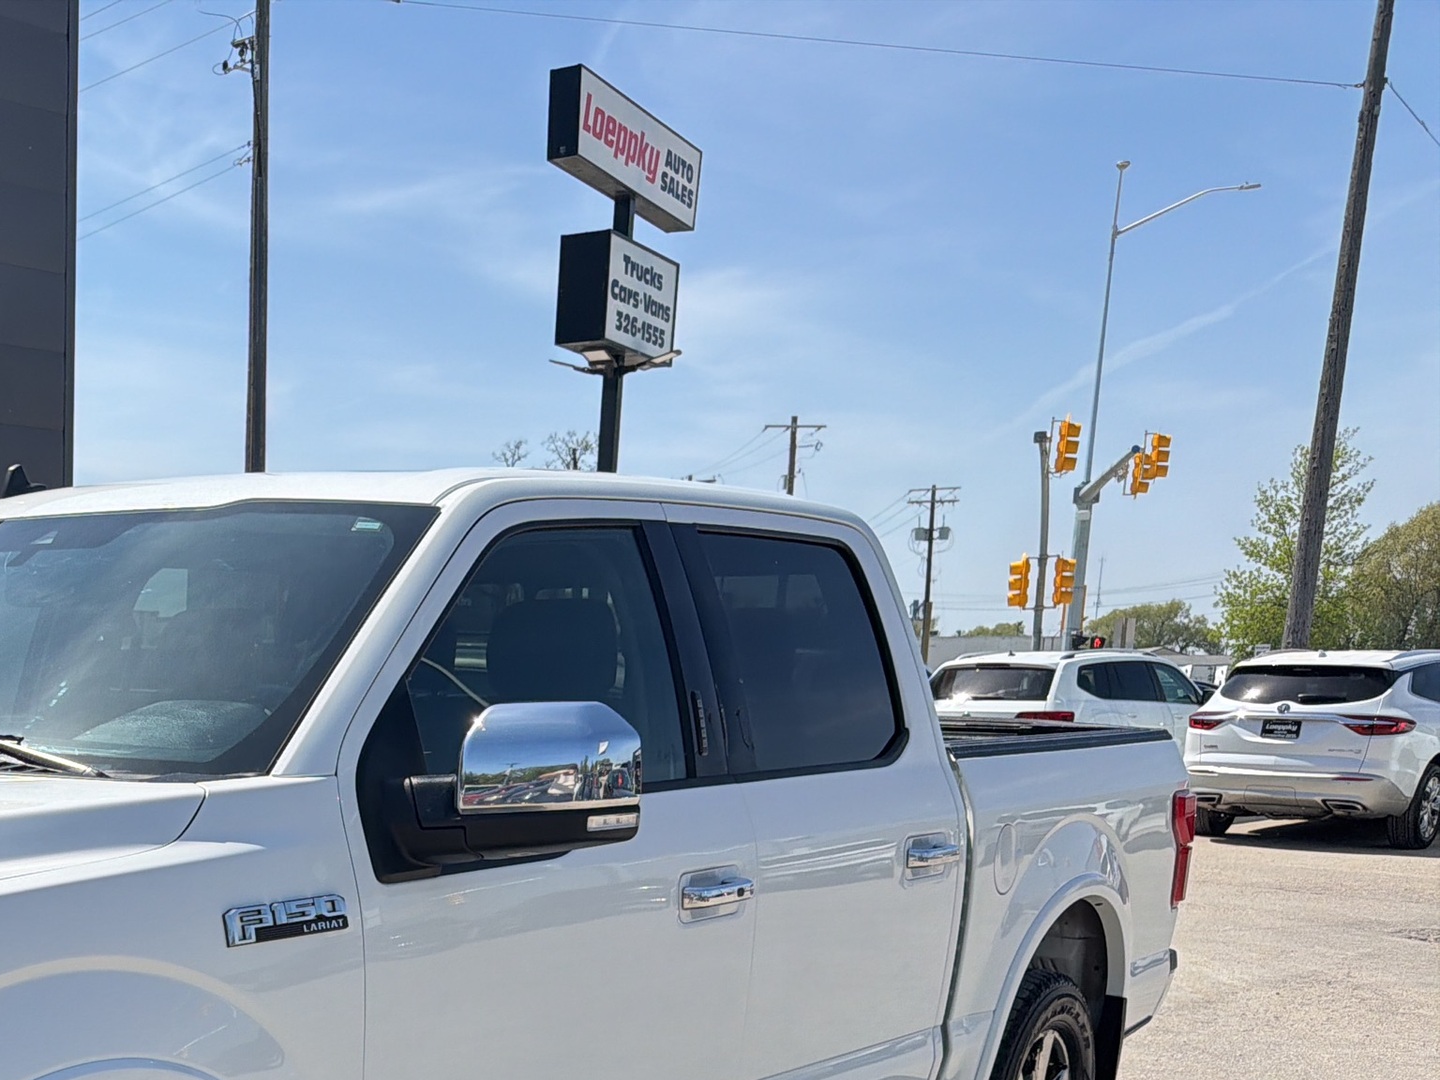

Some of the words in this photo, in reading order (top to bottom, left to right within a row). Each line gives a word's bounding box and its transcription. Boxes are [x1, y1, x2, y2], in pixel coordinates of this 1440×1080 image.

[583, 92, 661, 185] Loeppky
[665, 149, 694, 184] AUTO
[660, 171, 694, 209] SALES
[623, 253, 664, 292] Trucks
[303, 918, 345, 933] LARIAT
